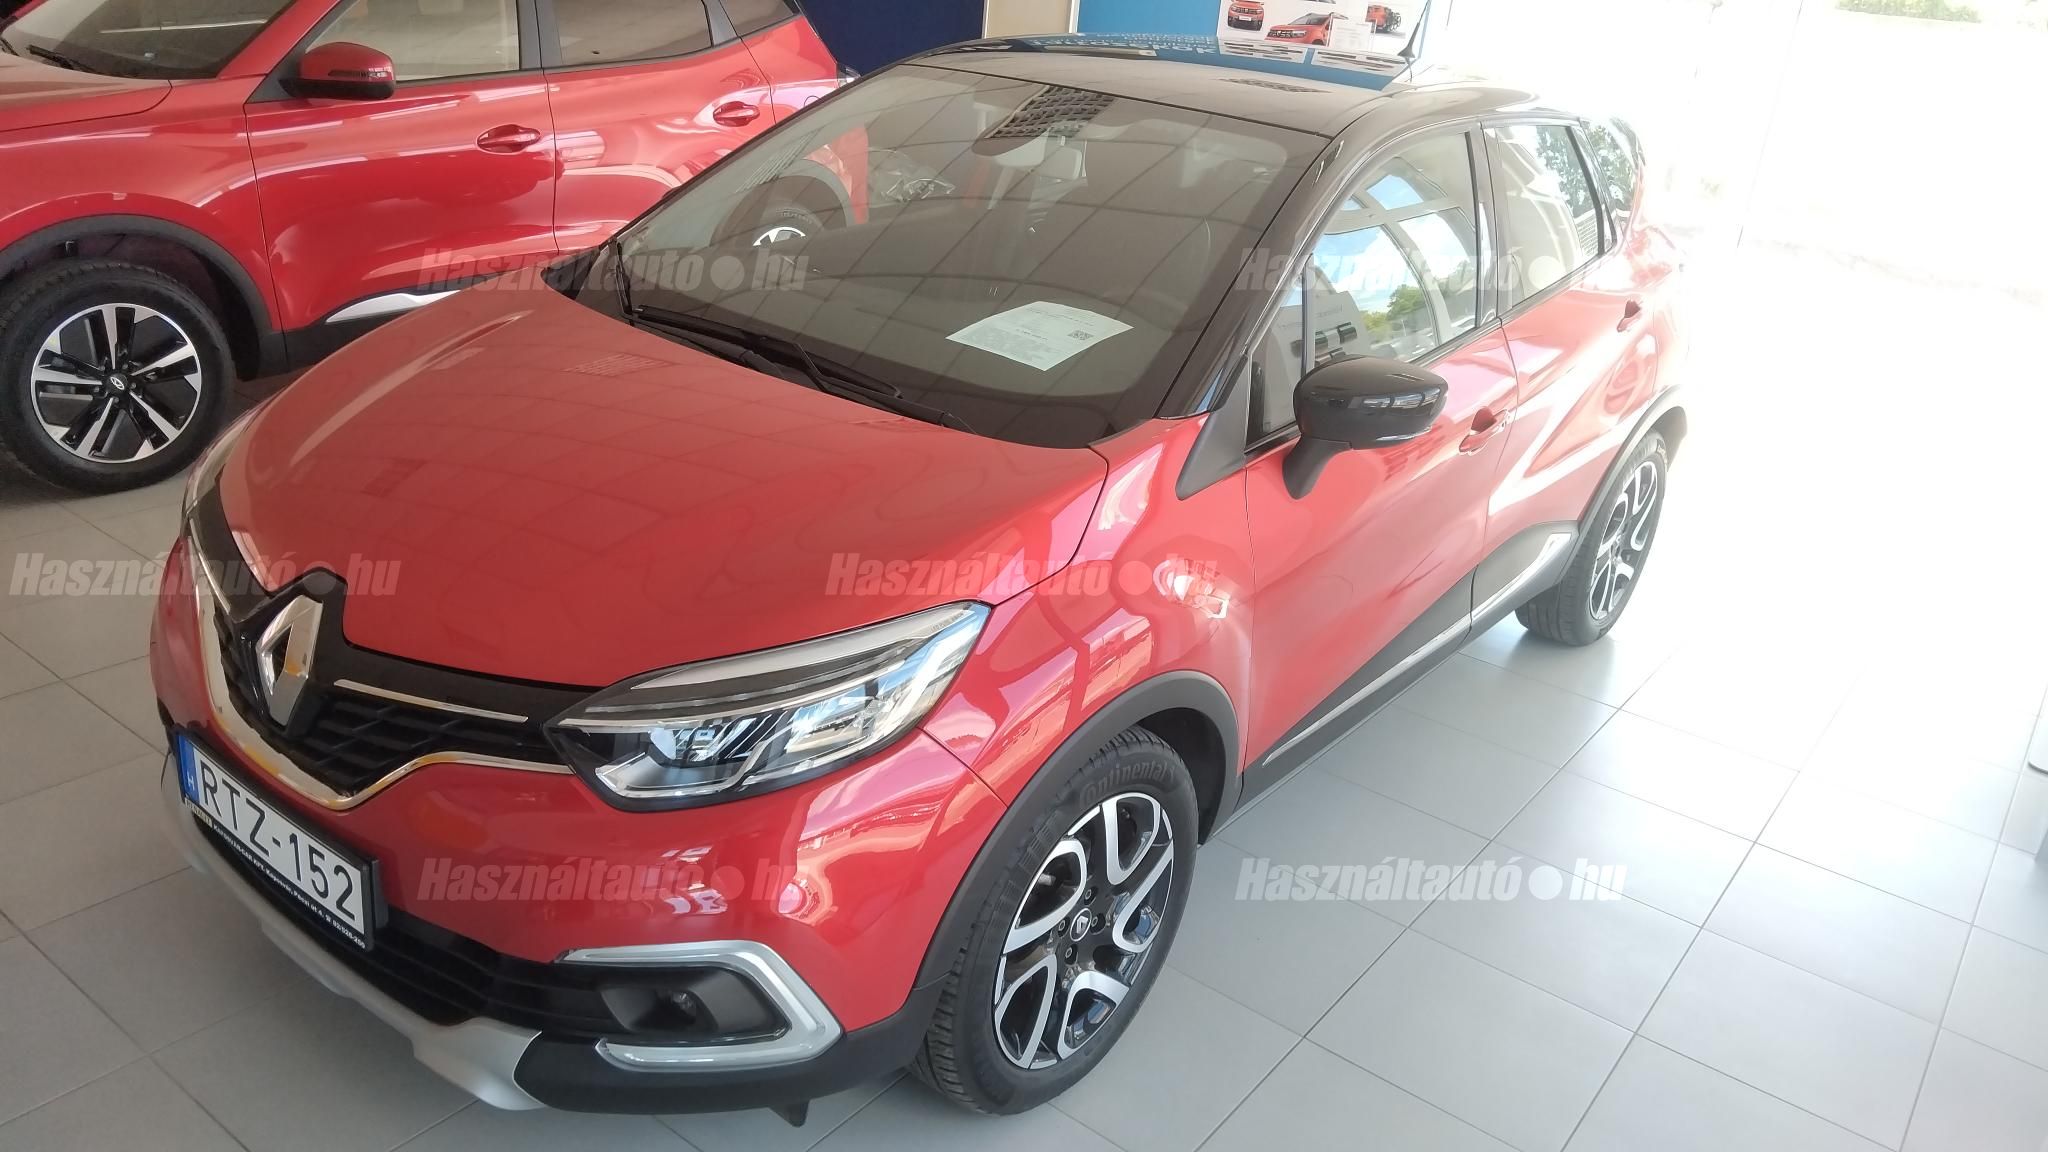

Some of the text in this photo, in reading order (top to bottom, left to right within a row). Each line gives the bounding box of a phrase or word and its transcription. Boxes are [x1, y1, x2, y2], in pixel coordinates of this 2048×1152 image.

[187, 777, 195, 791] H
[1079, 760, 1167, 808] Continental
[200, 760, 355, 920] RTZ-152
